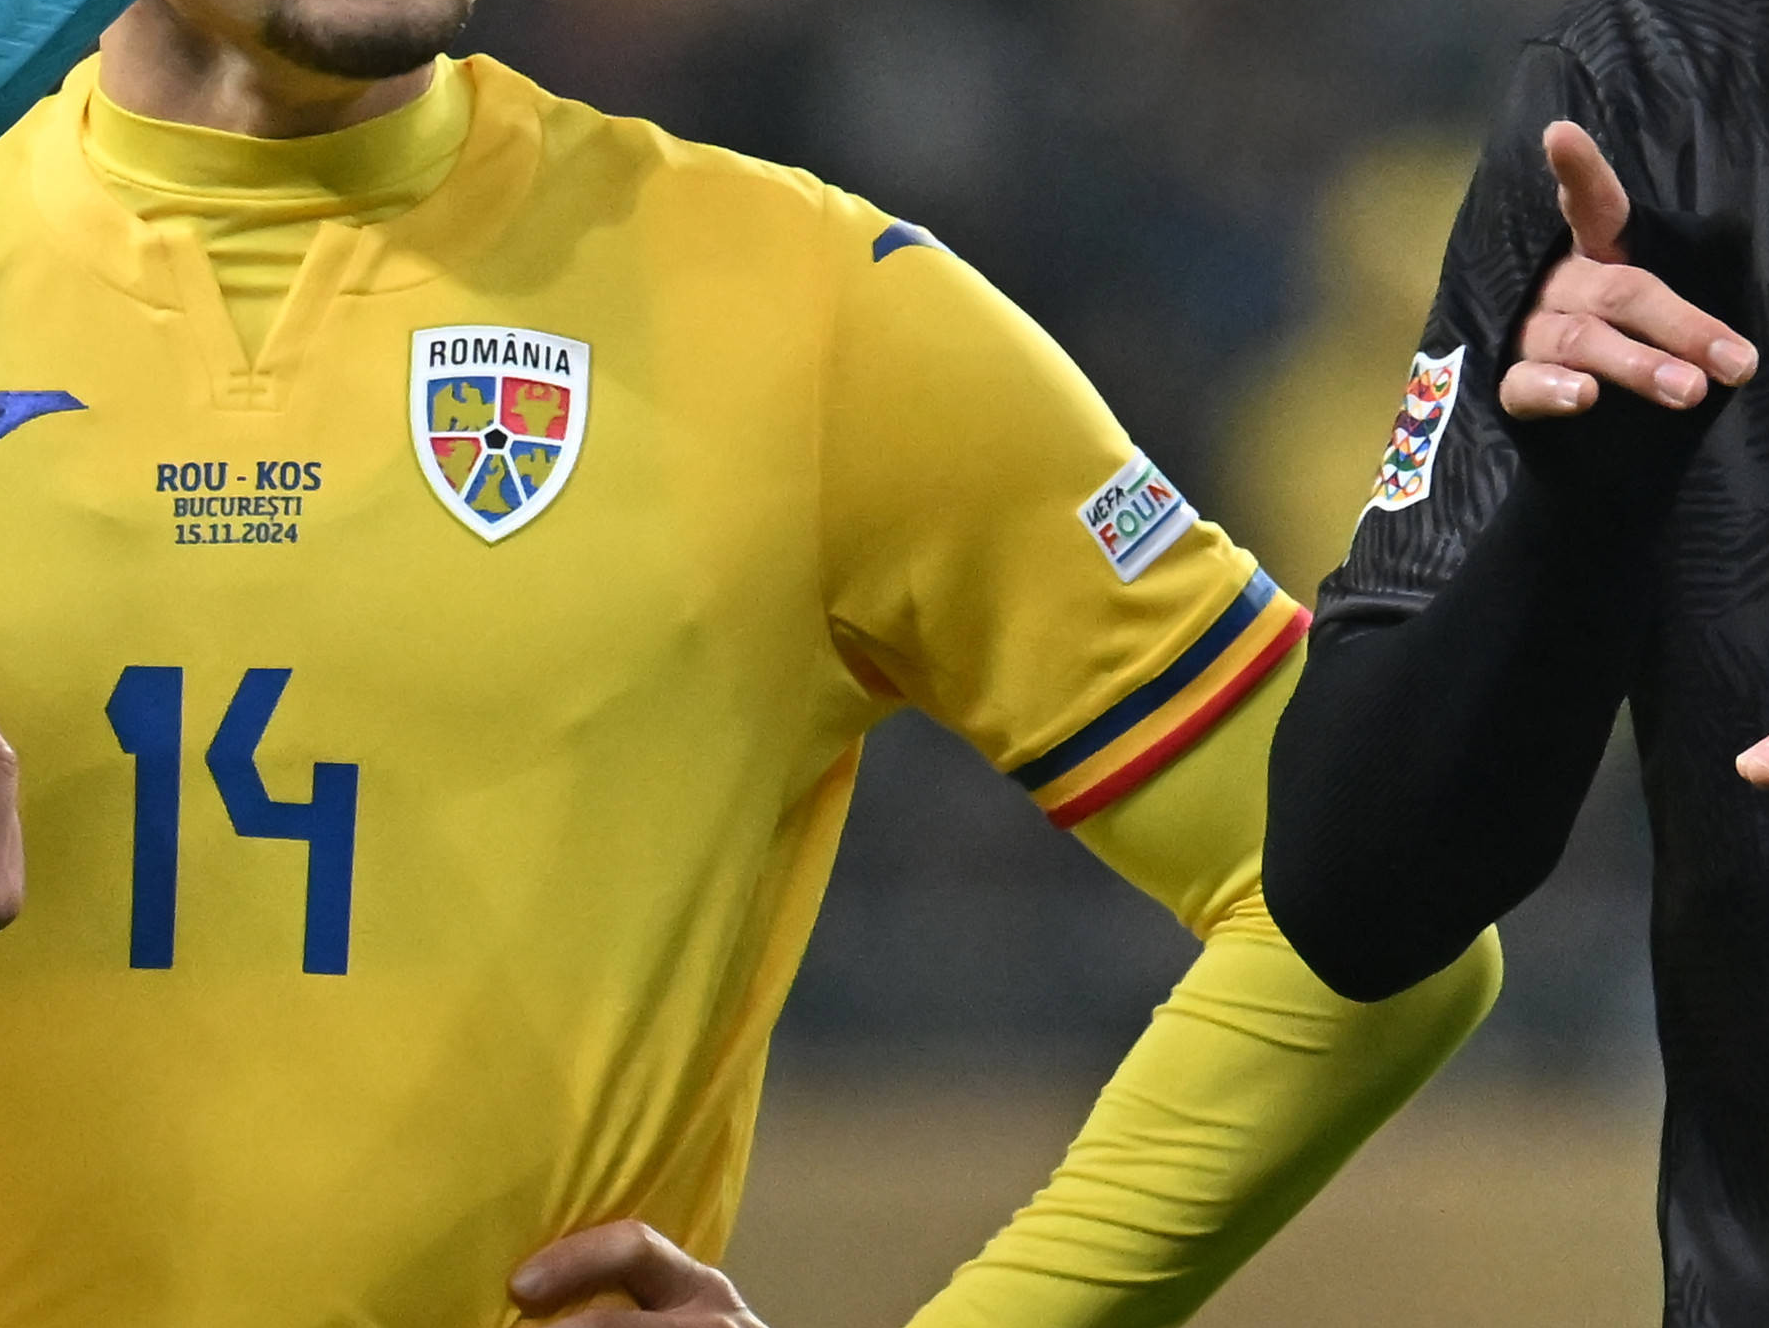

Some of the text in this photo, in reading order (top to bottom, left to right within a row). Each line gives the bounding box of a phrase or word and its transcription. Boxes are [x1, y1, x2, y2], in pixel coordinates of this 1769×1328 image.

[429, 332, 571, 376] ROMÂNIA
[156, 462, 229, 493] ROU
[255, 460, 323, 492] KOS
[1085, 484, 1126, 528] UEFA
[174, 522, 299, 545] 15.11.2024
[104, 664, 360, 976] 14
